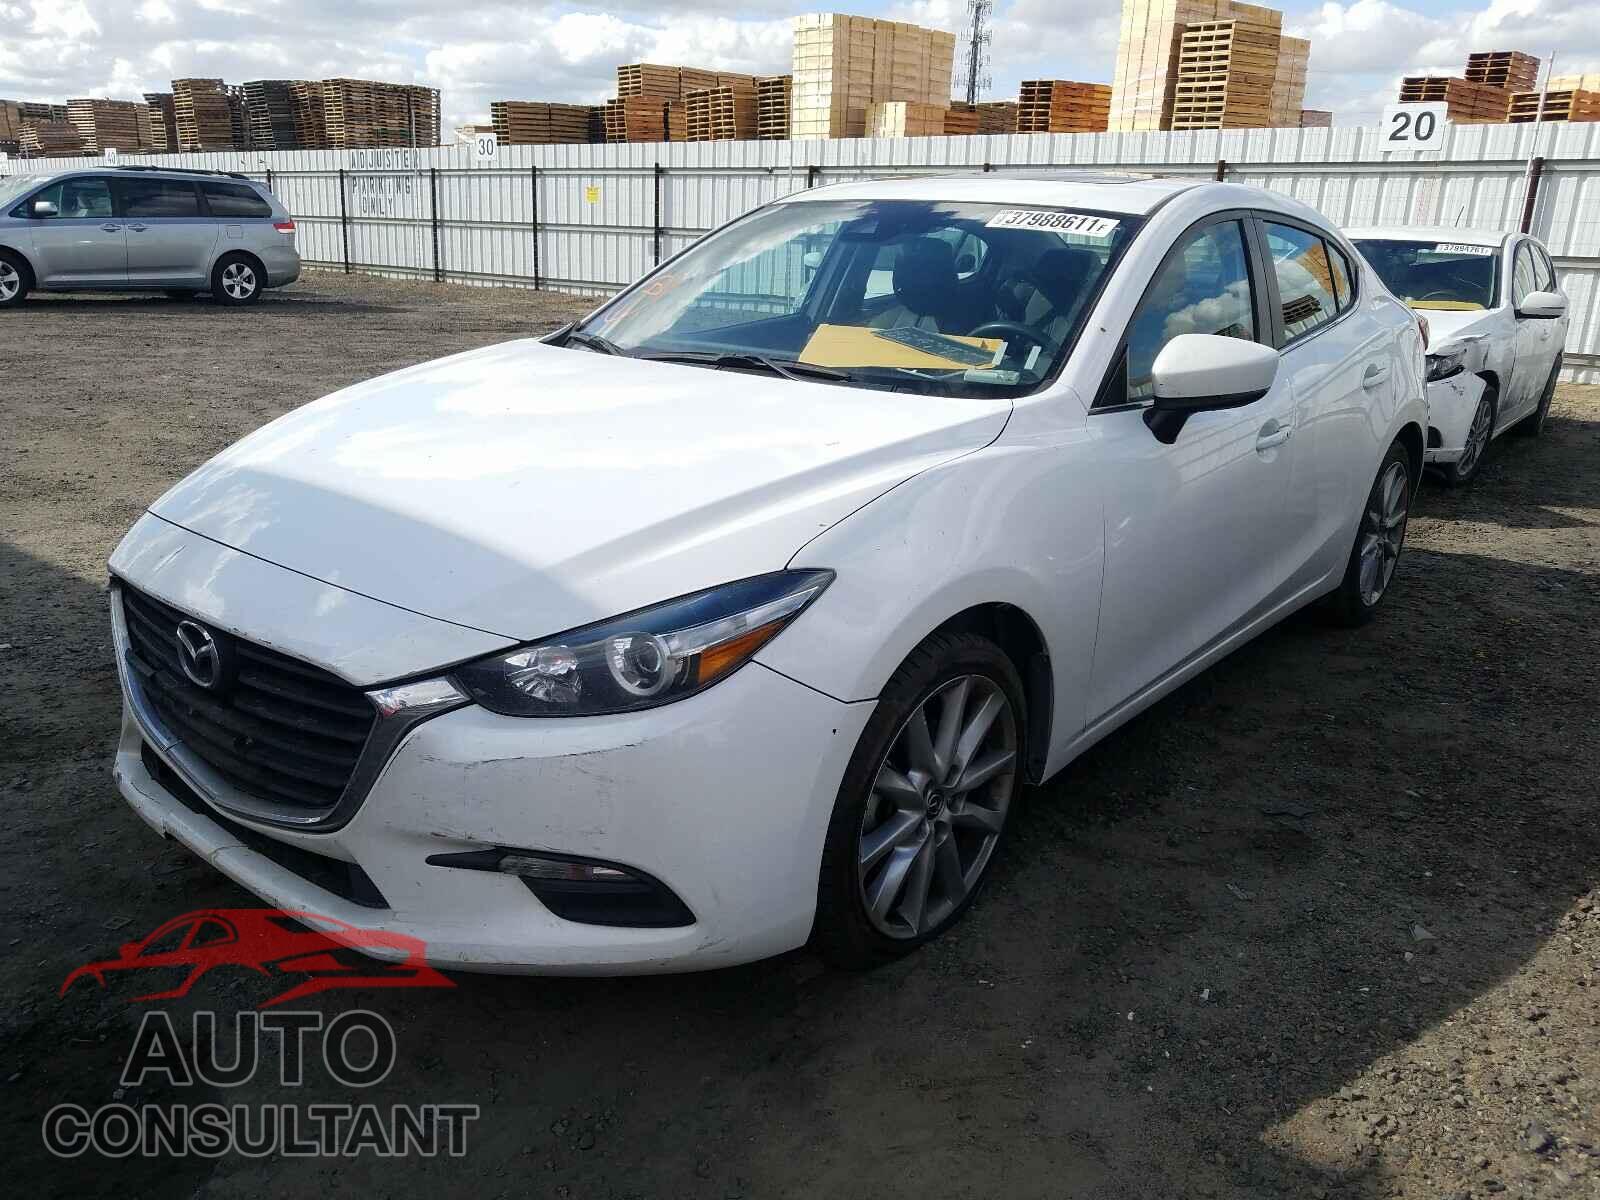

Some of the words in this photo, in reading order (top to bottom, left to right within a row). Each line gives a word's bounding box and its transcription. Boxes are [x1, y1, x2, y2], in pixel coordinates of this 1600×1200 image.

[1388, 111, 1436, 141] 20
[478, 138, 494, 156] 30
[351, 149, 419, 169] ADJUSTER
[352, 175, 411, 195] PARKING
[362, 196, 393, 216] ONLY
